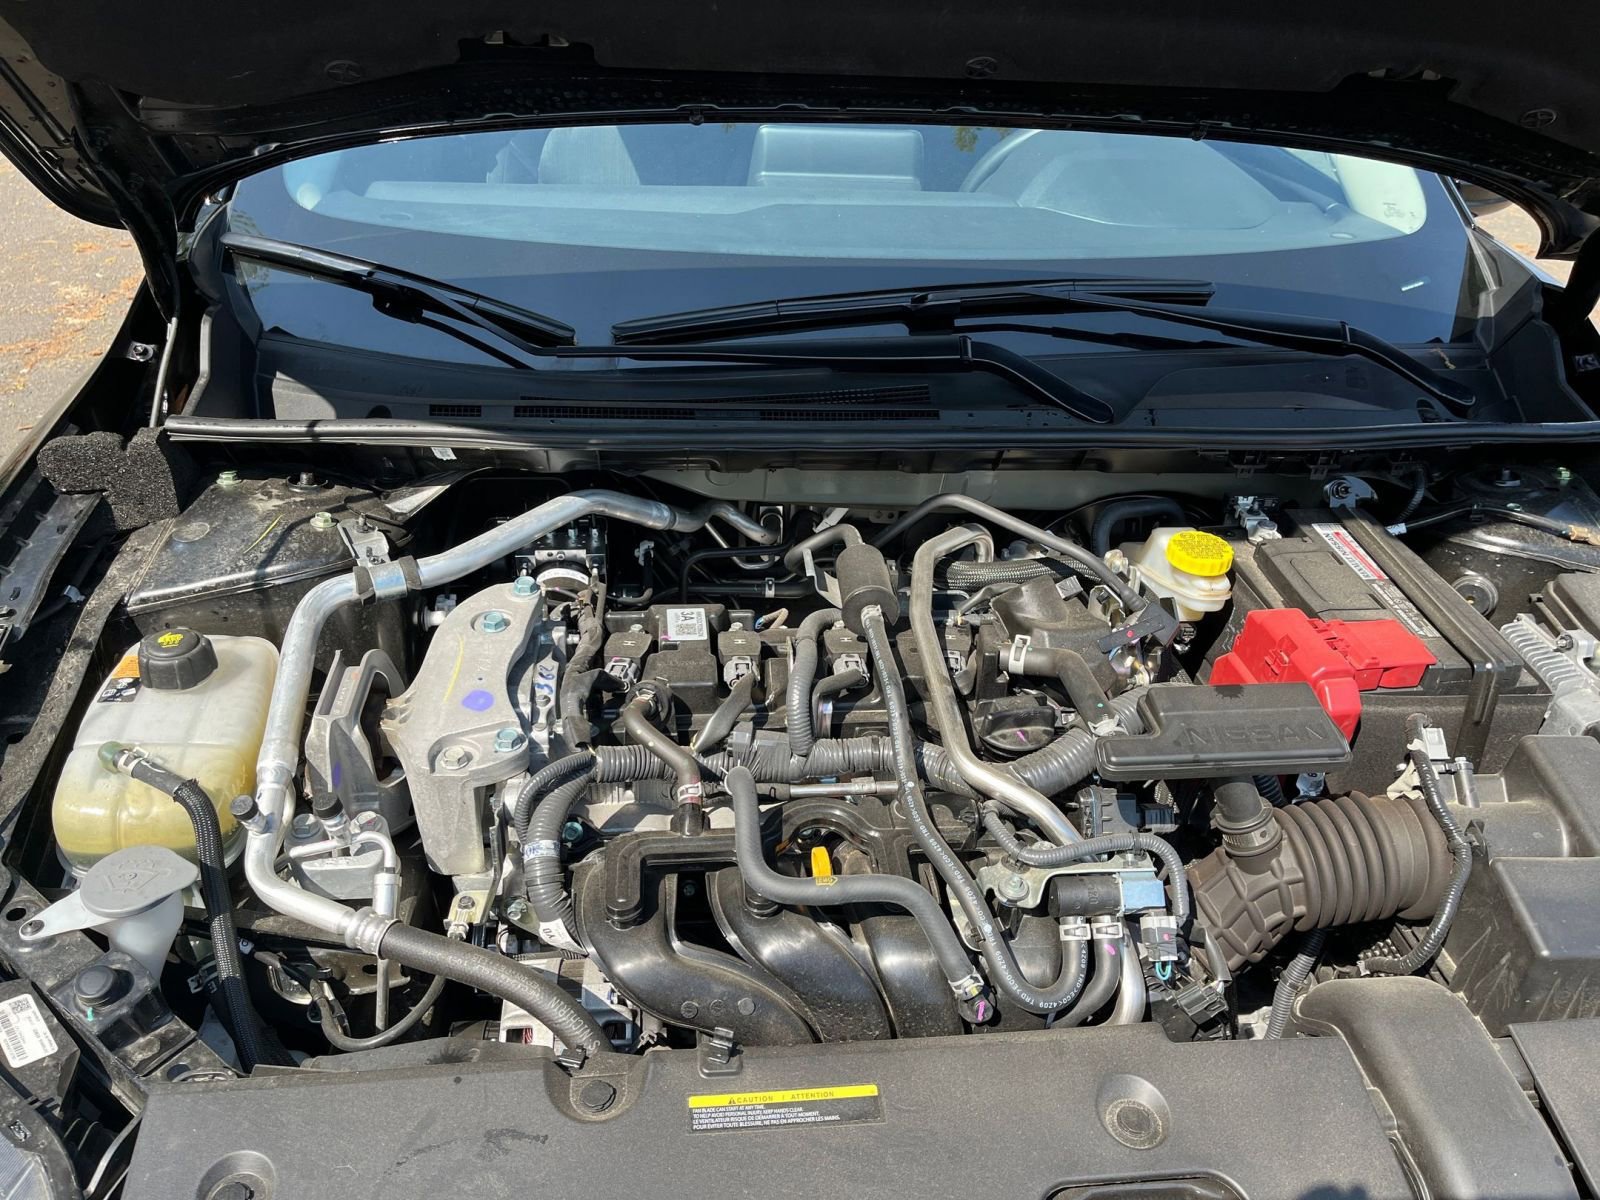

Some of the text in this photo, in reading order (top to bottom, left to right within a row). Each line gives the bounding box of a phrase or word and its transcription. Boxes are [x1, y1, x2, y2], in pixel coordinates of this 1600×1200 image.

[1180, 723, 1329, 746] NISSAN
[736, 1095, 773, 1104] CAUTION
[791, 1091, 834, 1100] ATTENTION
